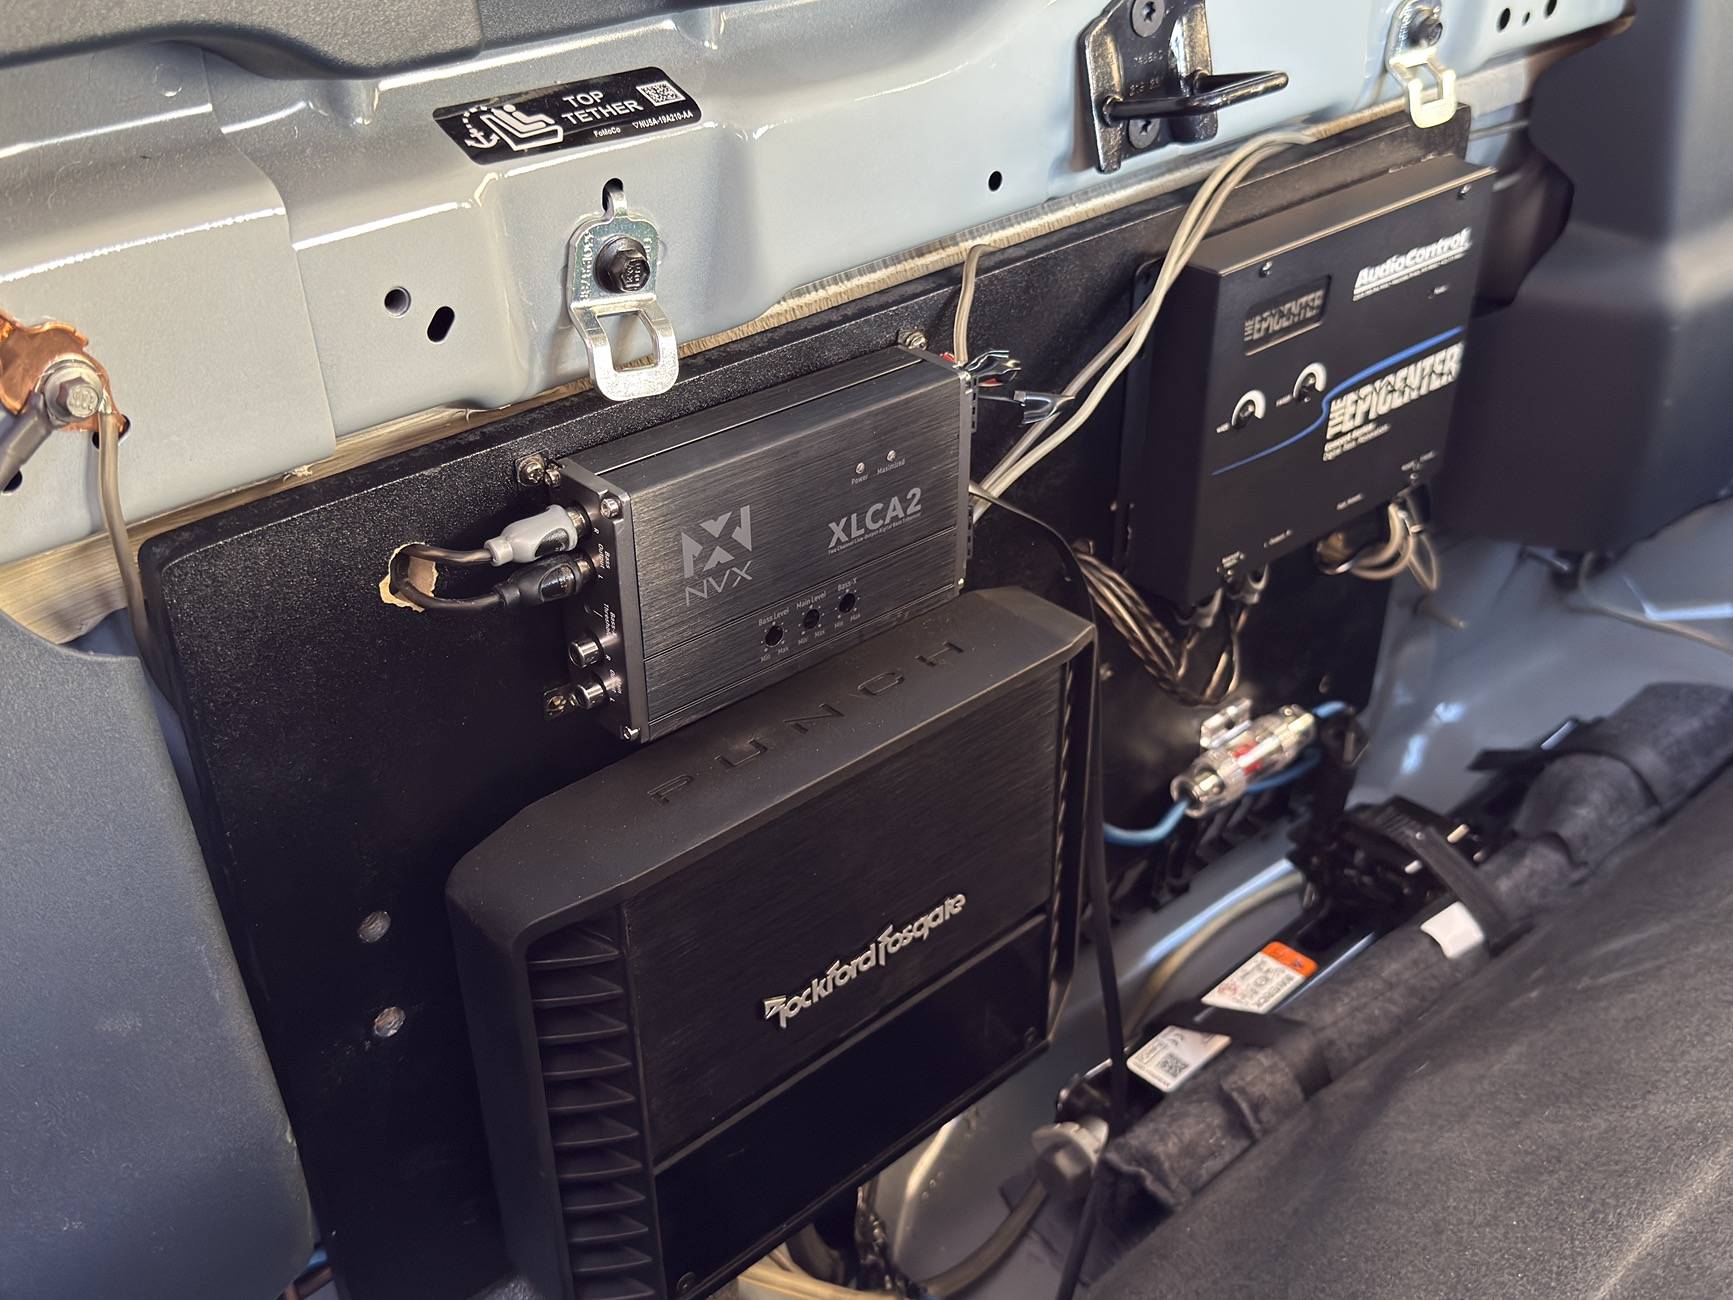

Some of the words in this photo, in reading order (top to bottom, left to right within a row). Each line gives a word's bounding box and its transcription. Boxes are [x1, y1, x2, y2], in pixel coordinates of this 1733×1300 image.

[562, 91, 604, 109] TOP
[562, 99, 643, 126] TETHER
[593, 126, 621, 138] FoMoCo
[1354, 226, 1472, 288] AudioControl
[1341, 341, 1465, 434] EPICENTER
[851, 473, 869, 485] Power
[828, 487, 922, 549] XLCA2
[685, 560, 753, 607] NVX
[796, 598, 811, 611] Main
[811, 590, 827, 604] Level
[758, 615, 773, 627] Bass
[773, 607, 790, 621] Level
[647, 641, 964, 804] PUNCH
[764, 943, 876, 1029] Rockford
[877, 893, 967, 967] Fosgate
